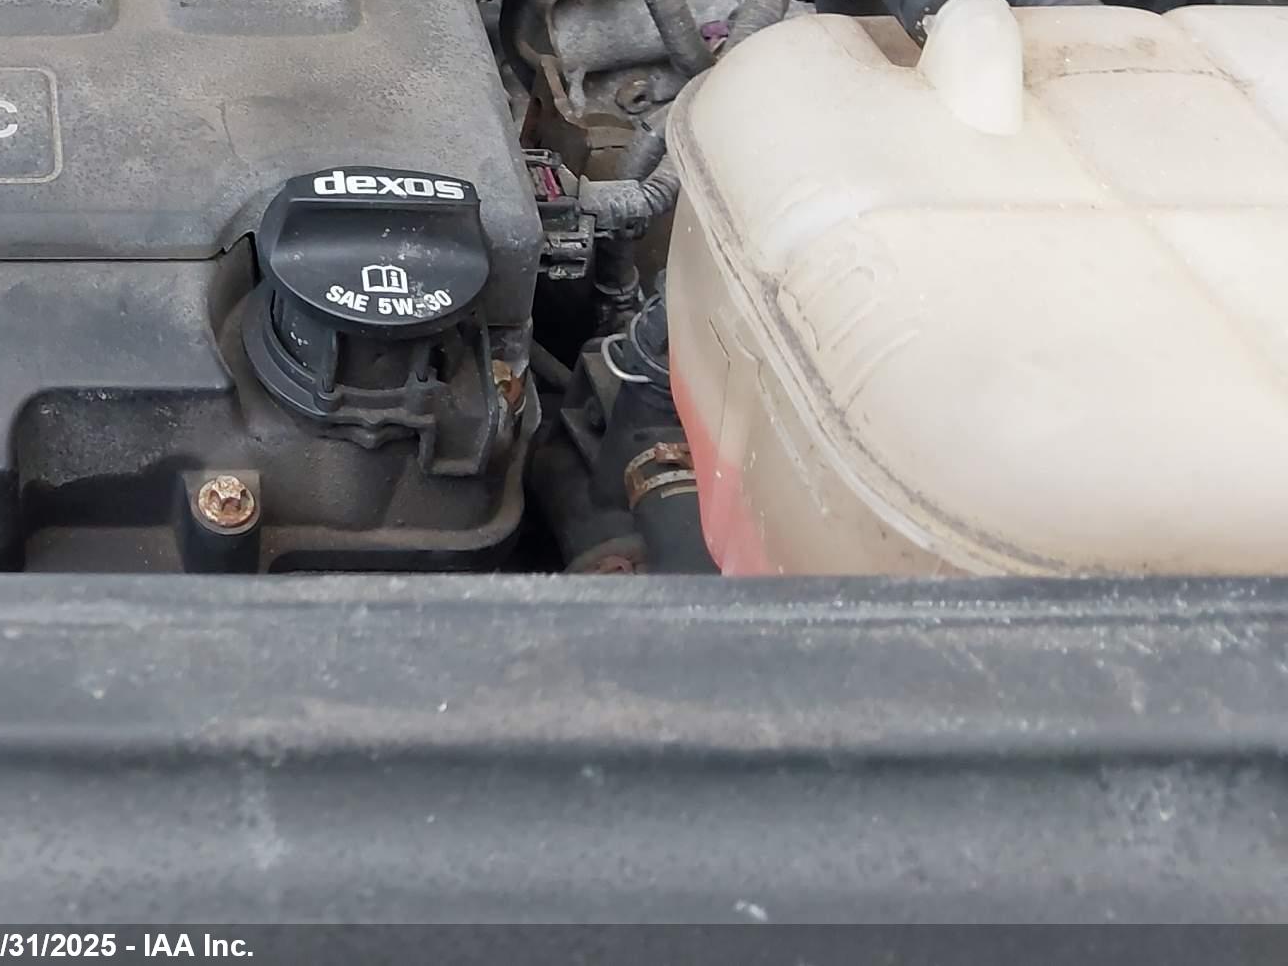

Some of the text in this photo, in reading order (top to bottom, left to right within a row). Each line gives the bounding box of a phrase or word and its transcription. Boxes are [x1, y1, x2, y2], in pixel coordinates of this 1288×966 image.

[313, 170, 465, 200] dexos
[325, 285, 453, 316] SAE 5W-30
